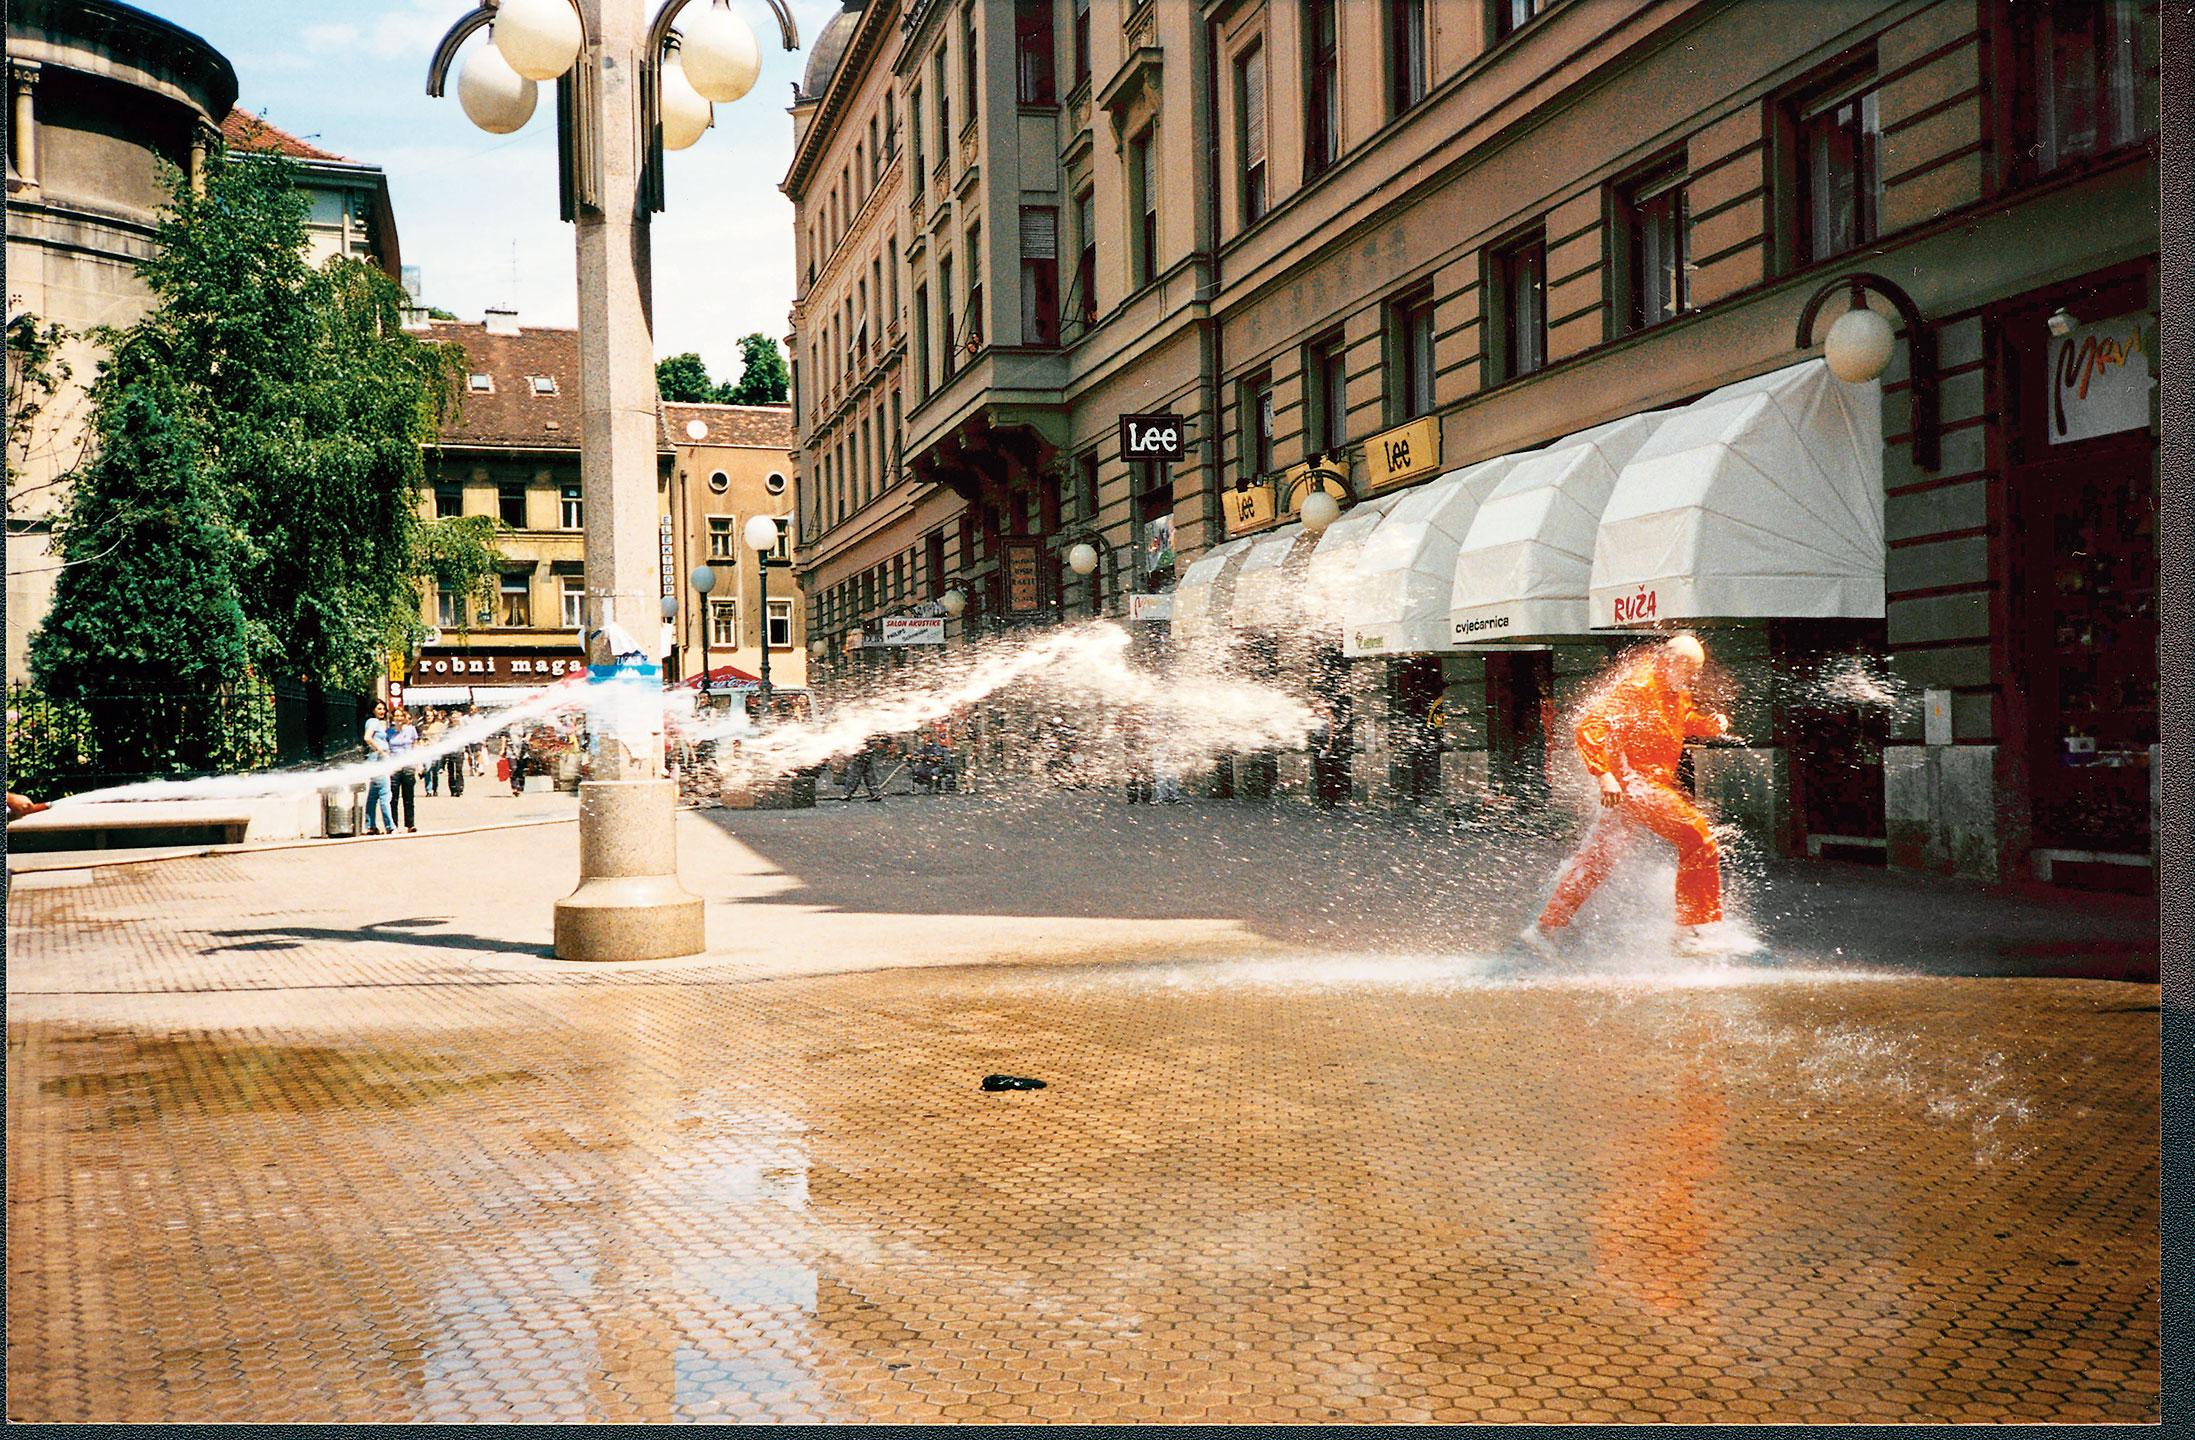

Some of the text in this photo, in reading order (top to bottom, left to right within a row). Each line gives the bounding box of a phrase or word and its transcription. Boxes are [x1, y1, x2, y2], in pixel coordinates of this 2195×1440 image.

[1128, 422, 1178, 452] Lee
[1384, 438, 1412, 474] Lee
[1235, 494, 1256, 522] Lee
[1614, 583, 1657, 624] RUŽA
[886, 619, 940, 628] SALON AKUSTIKE
[1455, 615, 1510, 635] cvjećarnica
[419, 656, 496, 674] robni
[510, 658, 583, 676] maga
